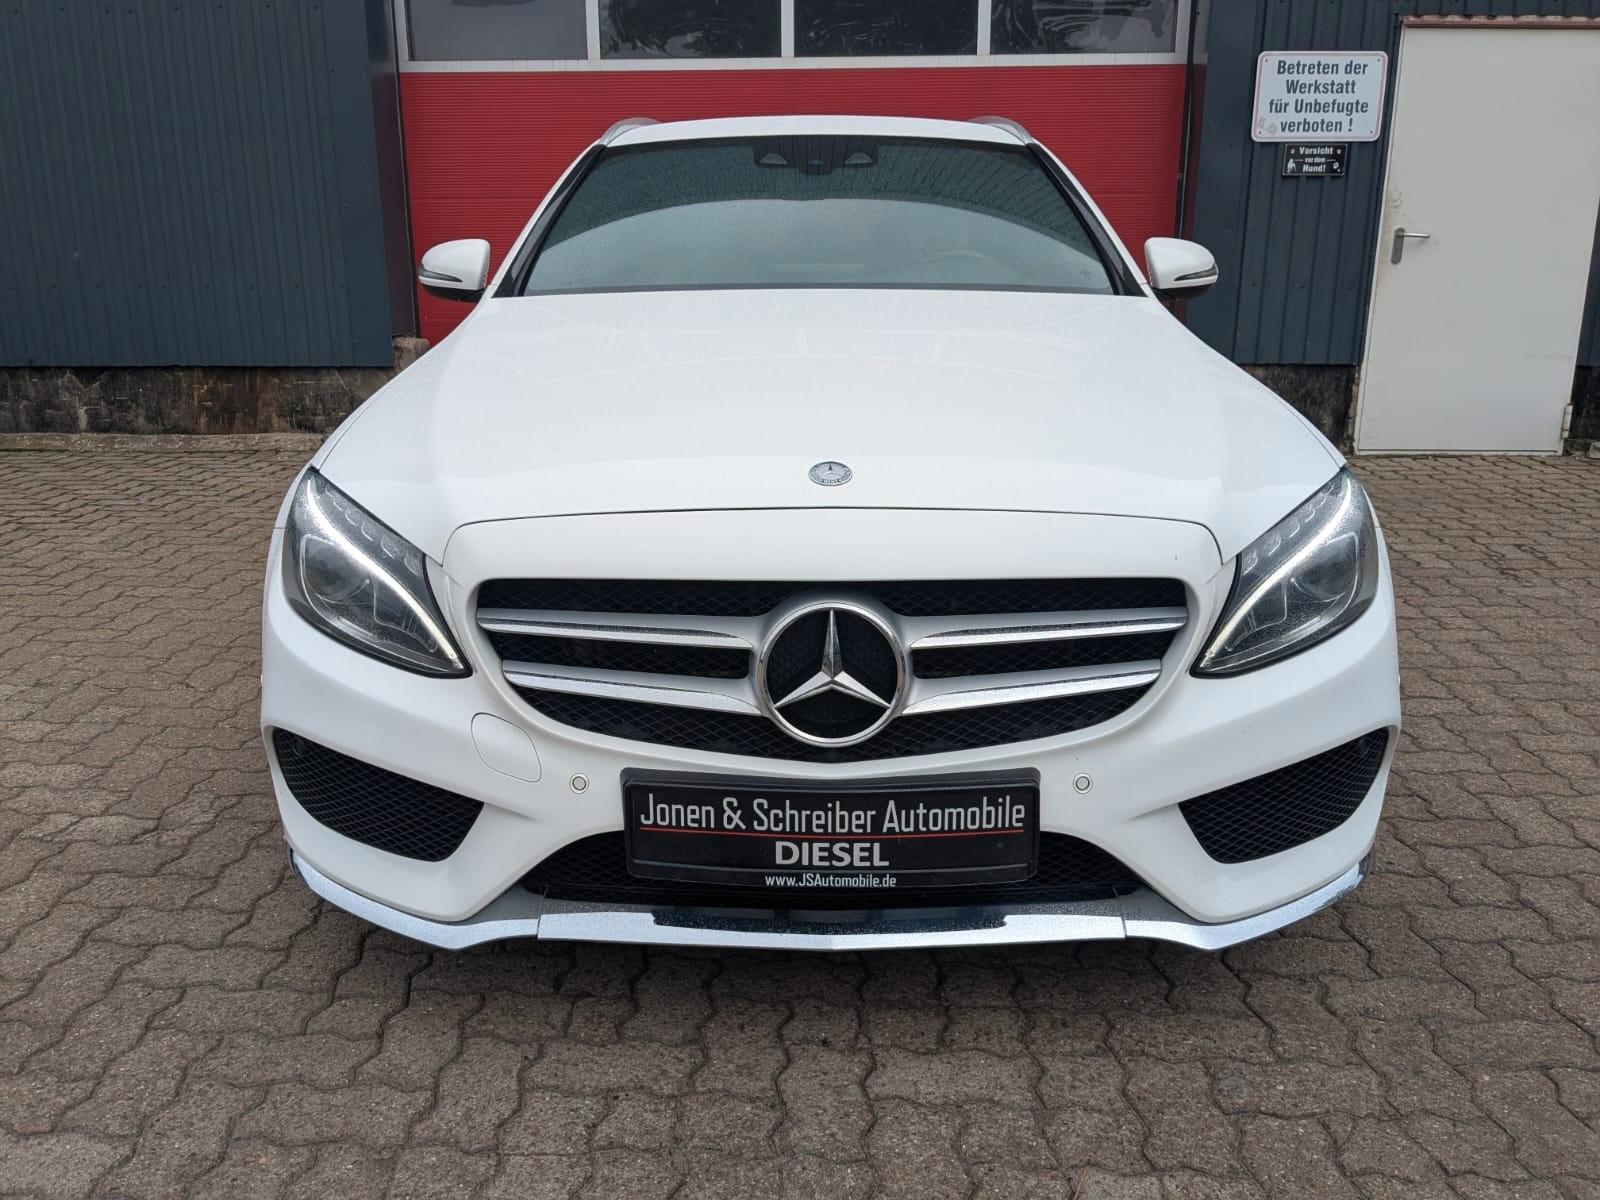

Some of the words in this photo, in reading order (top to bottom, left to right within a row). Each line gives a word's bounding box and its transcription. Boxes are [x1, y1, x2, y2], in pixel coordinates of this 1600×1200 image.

[1277, 60, 1339, 75] Betreten
[1344, 60, 1368, 75] der
[1286, 80, 1356, 94] Werkstatt
[1269, 99, 1289, 114] für
[1294, 99, 1368, 116] Unbefugte
[1280, 118, 1342, 133] verboten
[1348, 118, 1353, 132] !
[1299, 146, 1333, 155] Vorsicht
[1303, 163, 1326, 173] Hund!
[640, 793, 715, 829] Jonen
[722, 797, 746, 830] &
[753, 798, 876, 833] Schreiber
[882, 795, 1025, 833] Automobile
[775, 840, 890, 867] DIESEL
[764, 873, 897, 888] www.JSAutomobile.de
